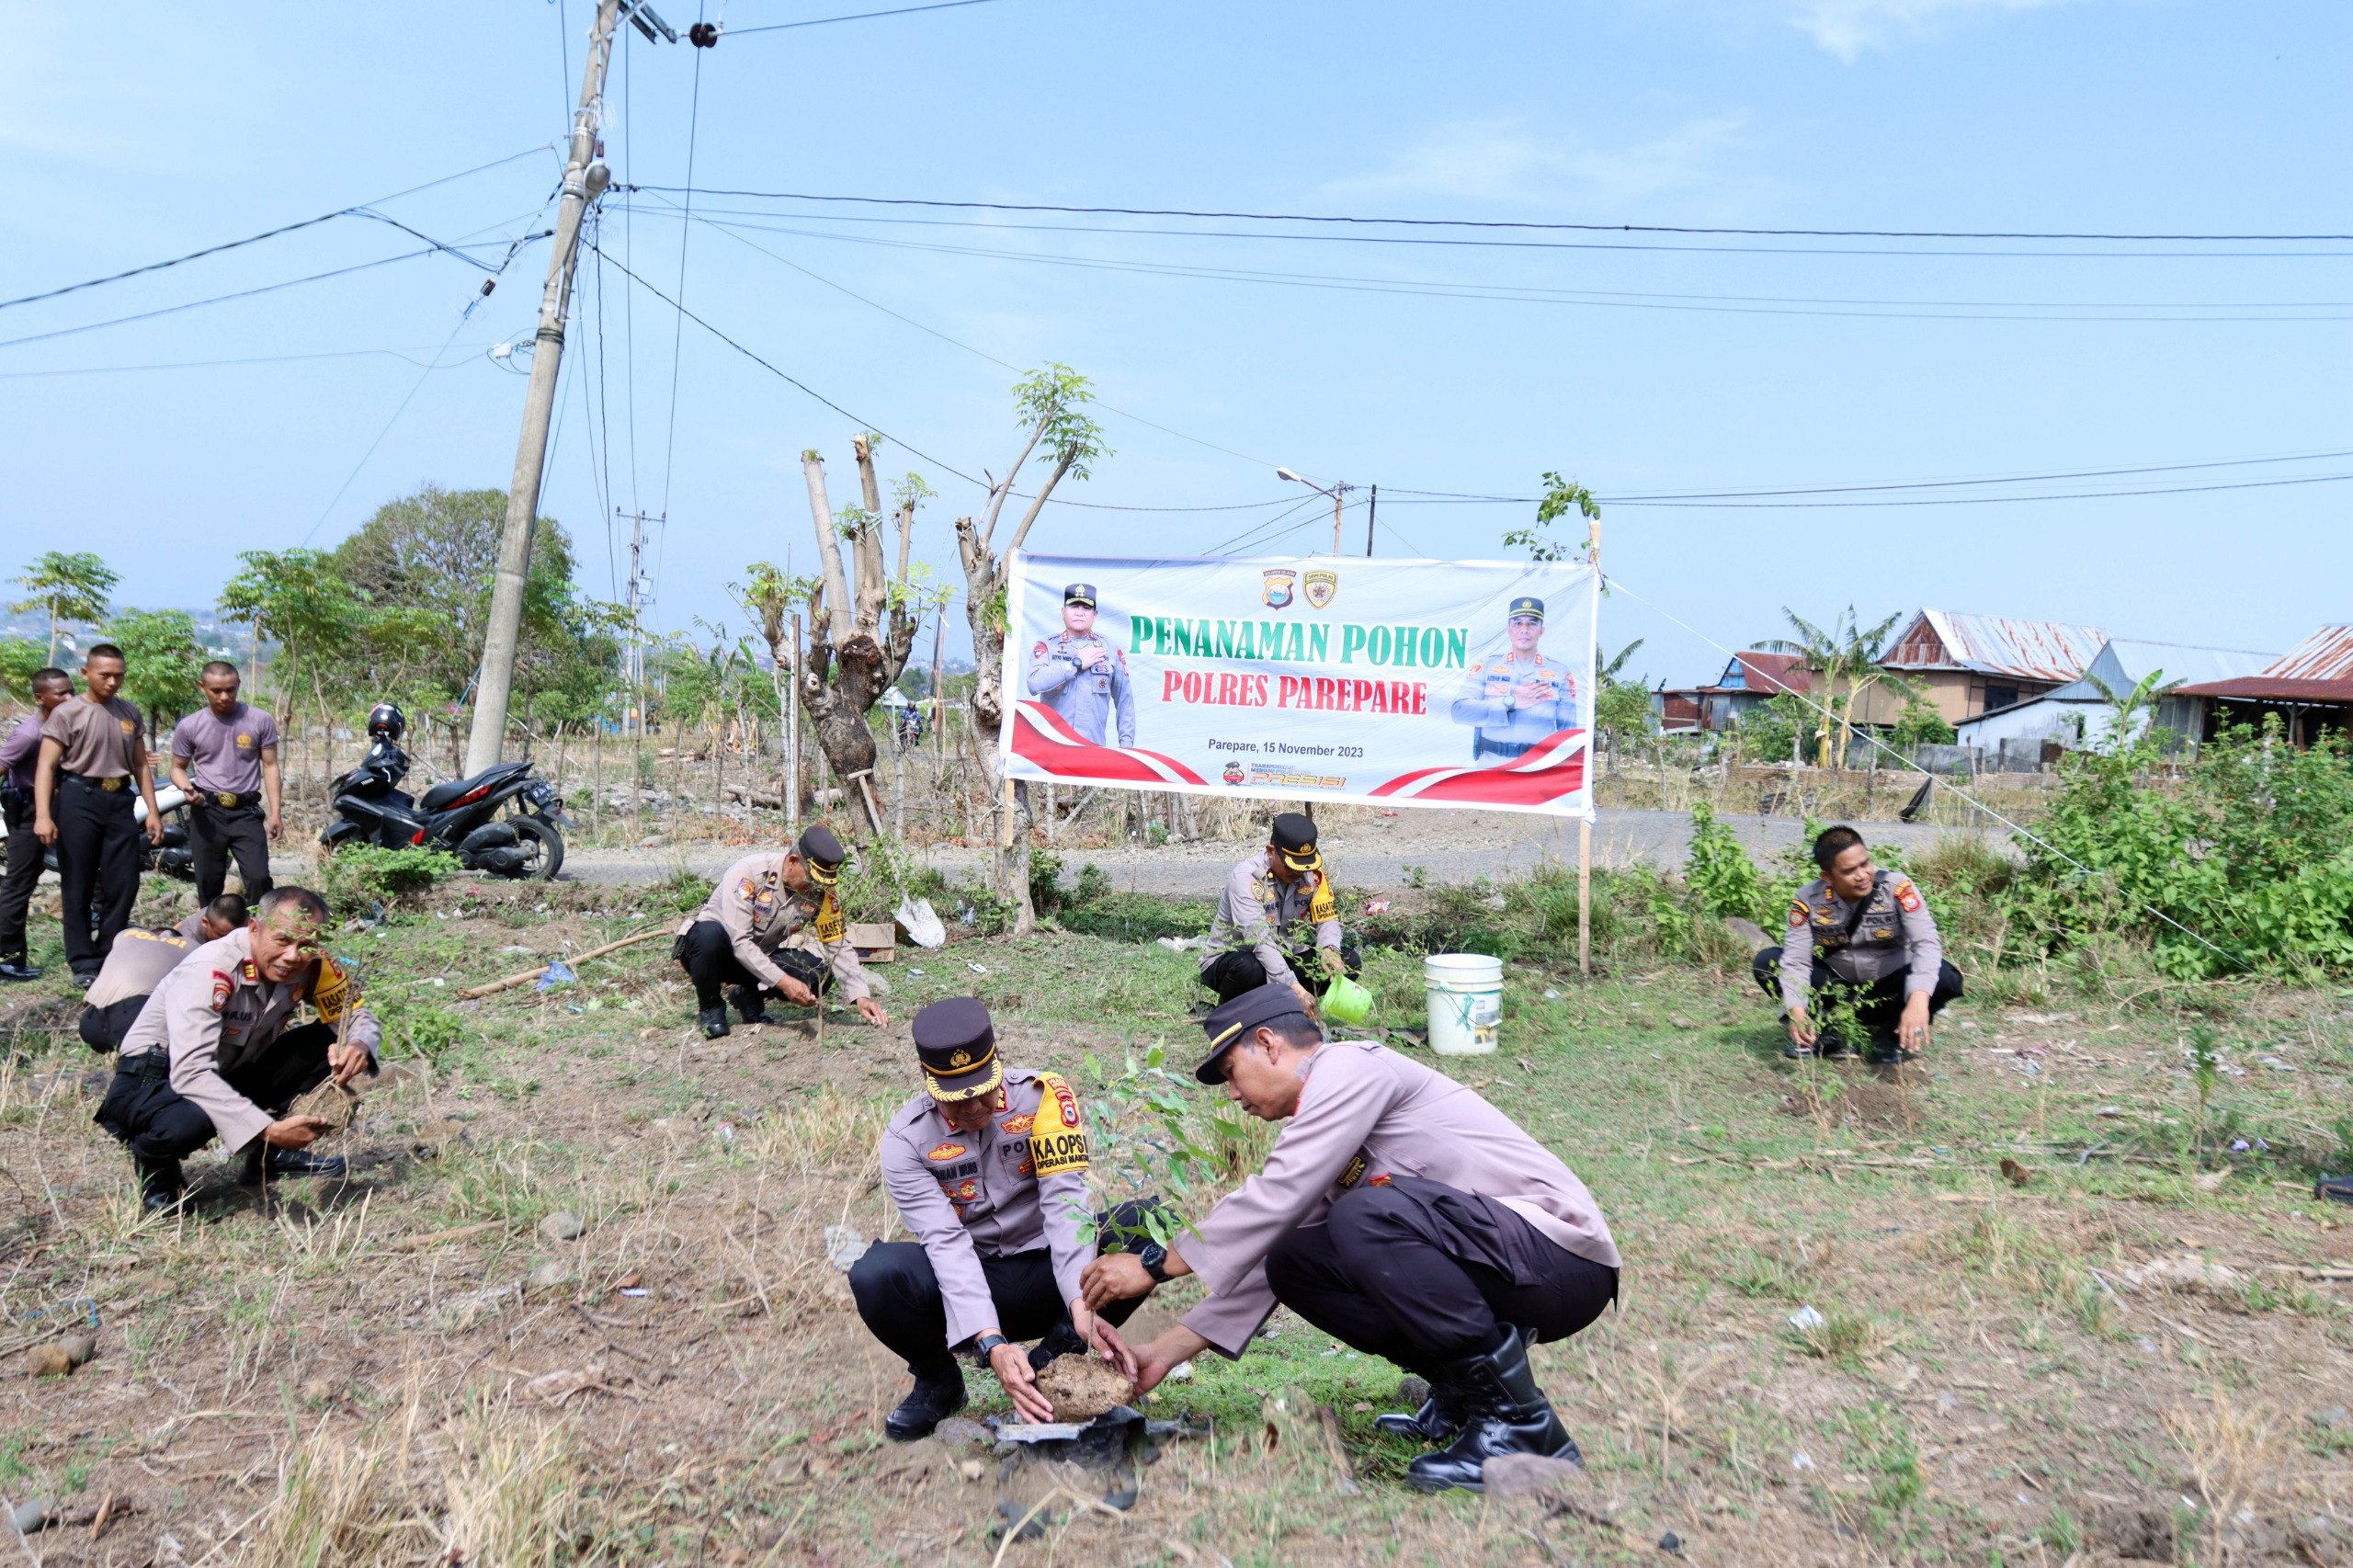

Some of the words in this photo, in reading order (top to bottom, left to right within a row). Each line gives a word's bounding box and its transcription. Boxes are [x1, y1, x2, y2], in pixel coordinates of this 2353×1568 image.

[1129, 615, 1330, 663] PENANAMAN
[1340, 624, 1469, 669] POHON
[1161, 670, 1268, 708] POLRES
[1277, 676, 1427, 715] PAREPARE
[1208, 738, 1259, 754] Parepare,
[1263, 742, 1276, 753] 15
[1279, 743, 1336, 756] November
[1337, 745, 1364, 758] 2023
[1250, 772, 1347, 789] PRESISI
[122, 929, 188, 949] POLISI
[1032, 1137, 1056, 1161] KA
[1037, 1155, 1068, 1169] OPERASI
